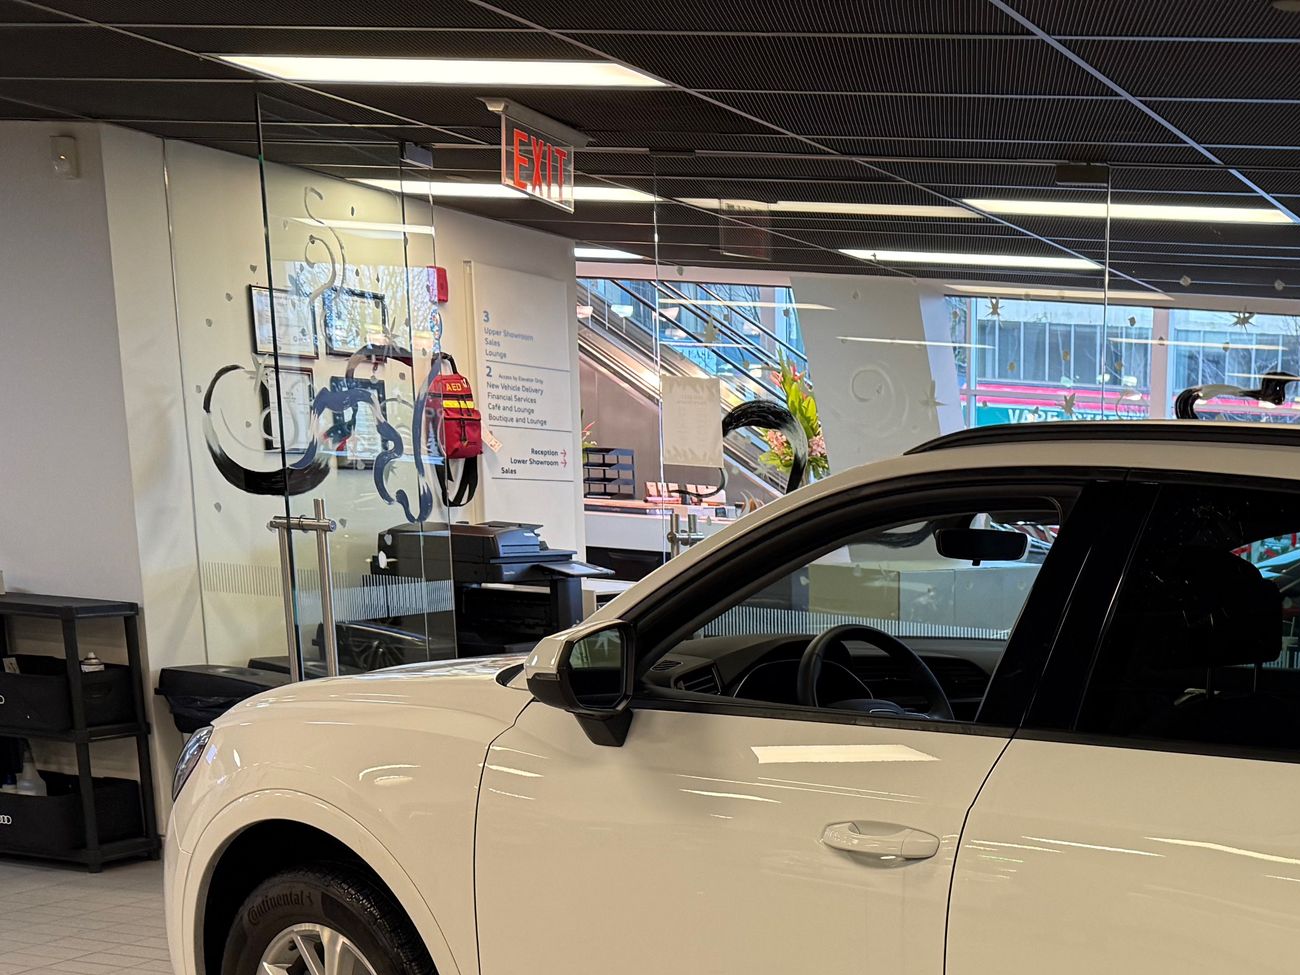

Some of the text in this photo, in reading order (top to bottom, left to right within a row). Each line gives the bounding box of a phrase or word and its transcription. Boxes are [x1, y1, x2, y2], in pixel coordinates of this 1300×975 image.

[513, 127, 568, 204] EXIT
[483, 310, 490, 323] 3
[484, 327, 534, 341] Upper Showroom
[485, 338, 501, 347] Sales
[485, 349, 507, 359] Lounge
[486, 366, 493, 377] 2
[446, 383, 462, 392] AED
[486, 381, 544, 396] New Vehicle Delivery
[487, 392, 537, 404] Financial Services
[488, 402, 535, 415] Café and Lounge
[488, 413, 547, 426] Boutique and Lounge
[531, 448, 559, 457] Reception
[510, 457, 559, 467] Lower Showroom
[501, 467, 517, 475] Sales
[247, 889, 305, 926] Continental
